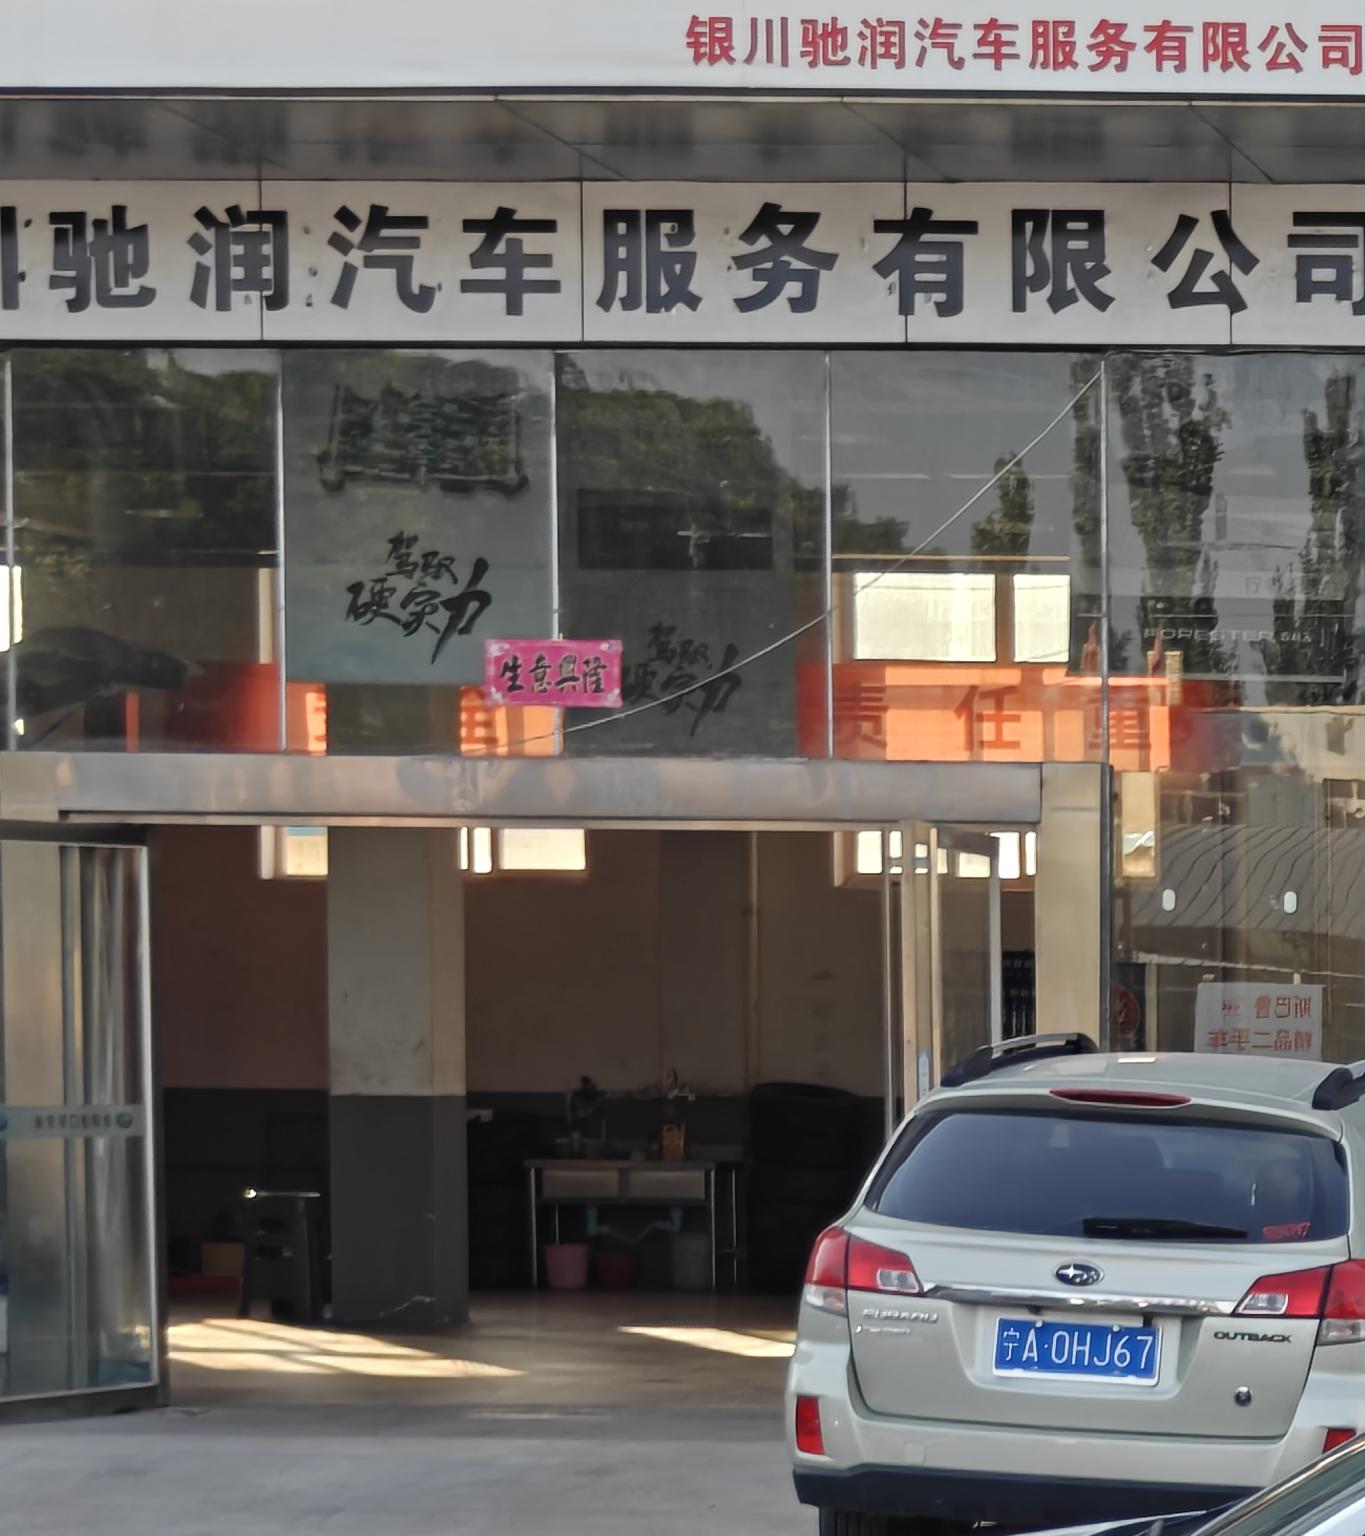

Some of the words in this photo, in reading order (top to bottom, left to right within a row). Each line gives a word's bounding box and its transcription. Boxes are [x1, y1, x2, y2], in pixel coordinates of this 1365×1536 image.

[685, 14, 1365, 76] 银川驰润汽车服务有限公司
[1213, 1330, 1293, 1344] OUTBACK
